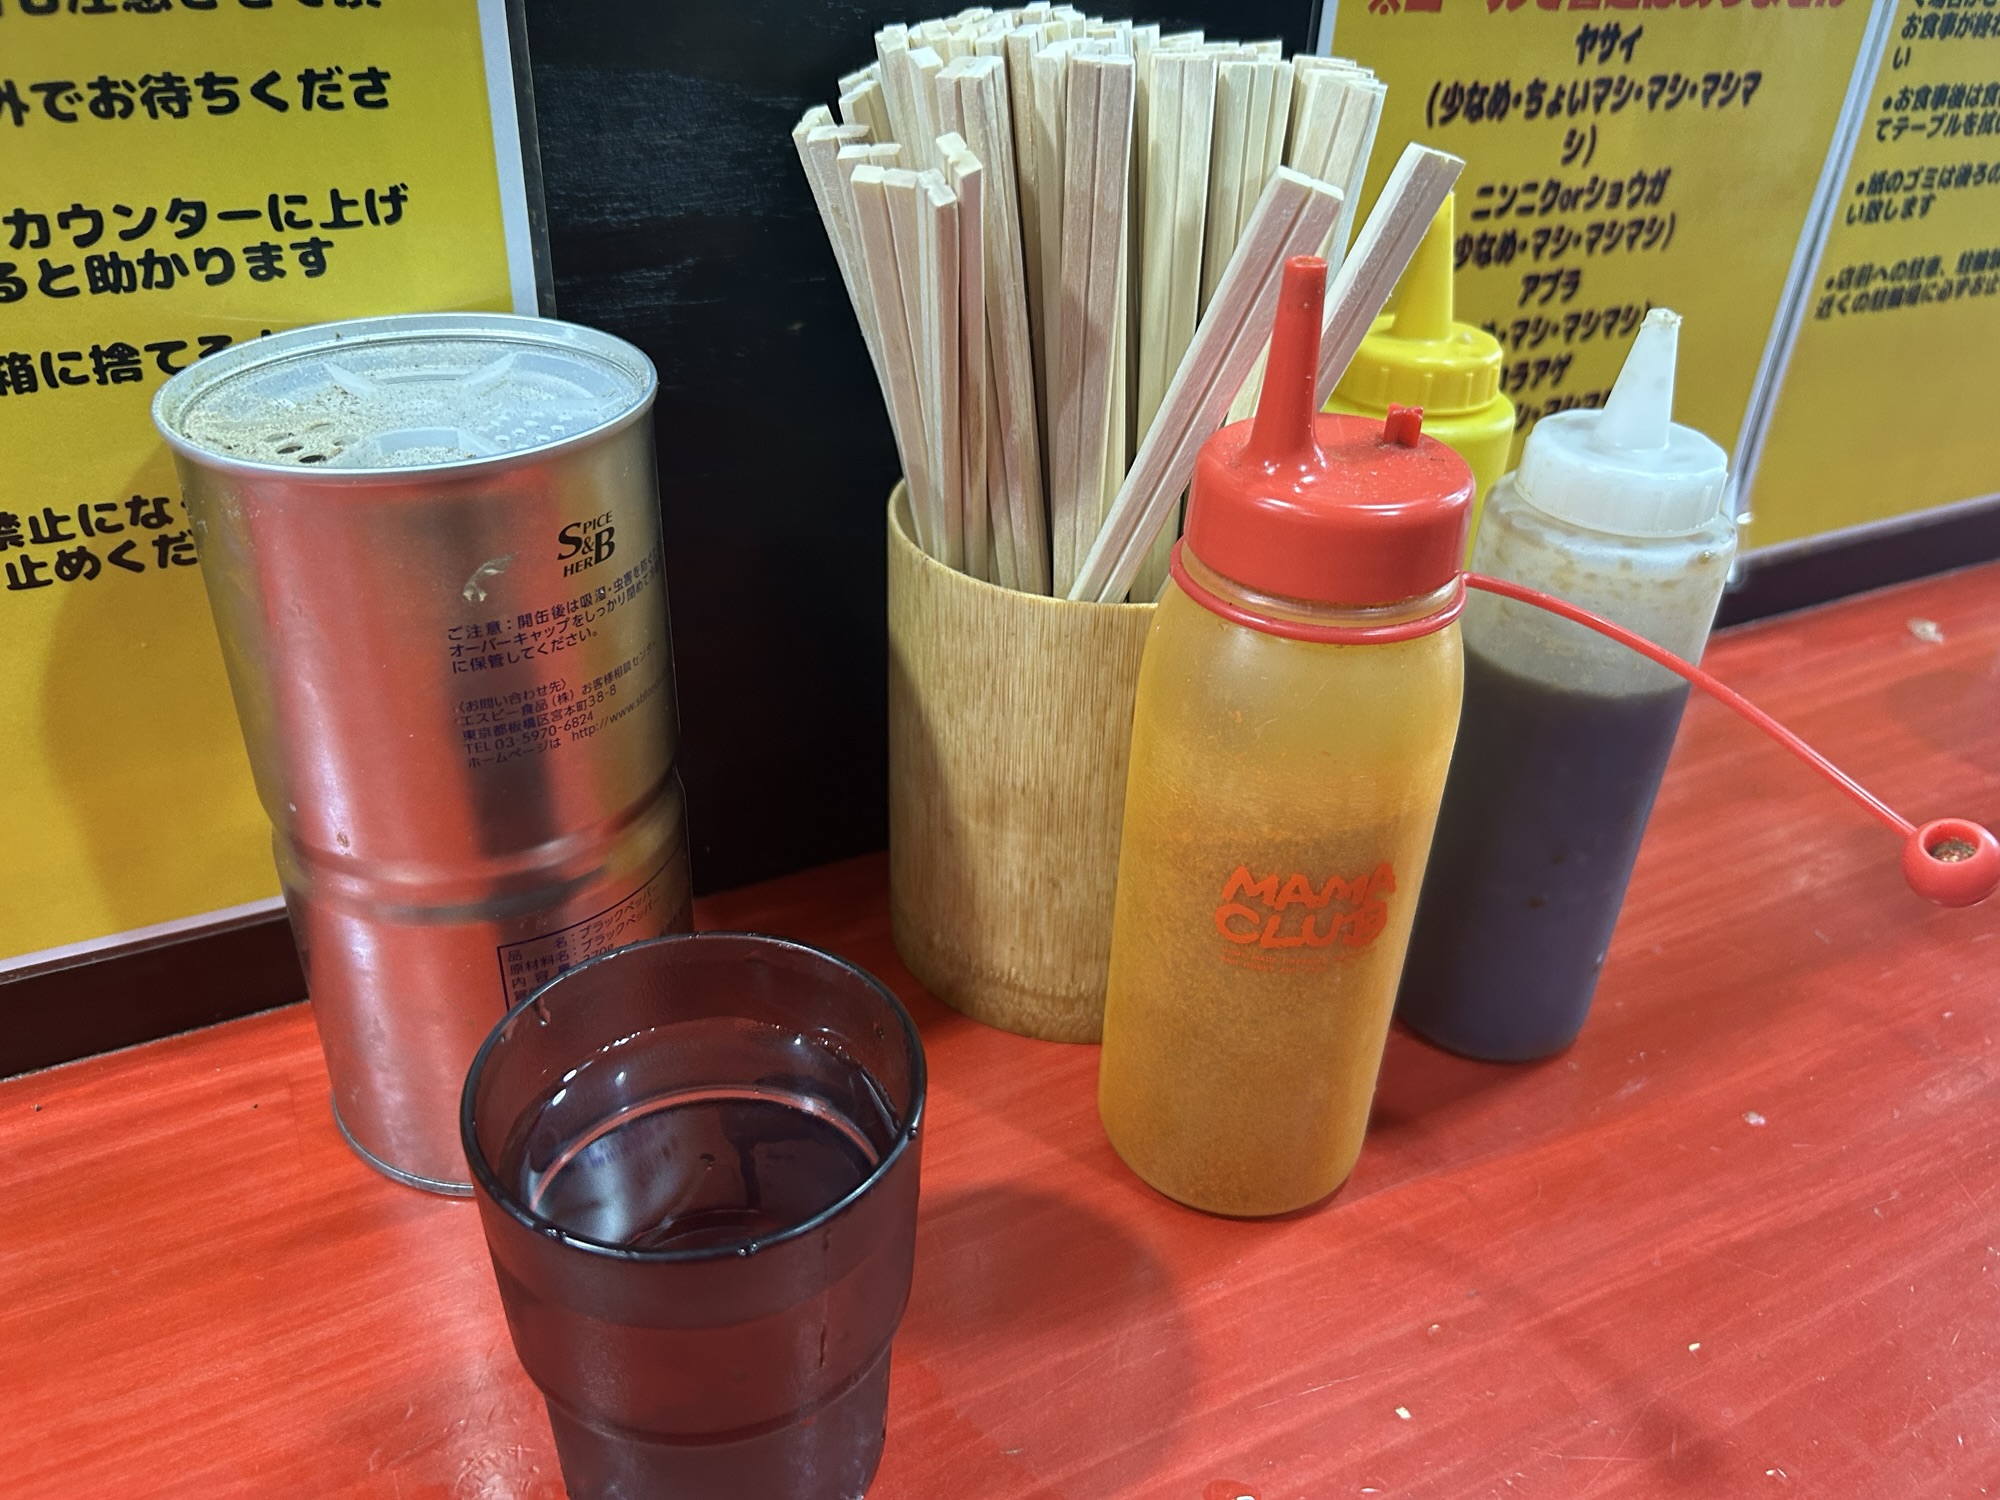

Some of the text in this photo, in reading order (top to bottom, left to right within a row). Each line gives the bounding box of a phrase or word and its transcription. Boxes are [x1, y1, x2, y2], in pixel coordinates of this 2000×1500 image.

[1575, 22, 1644, 67] ヤサイ
[1892, 45, 1911, 70] い
[1471, 167, 1672, 220] ニンニクorショウガ
[2, 184, 410, 251] カウンターに上げ
[0, 237, 335, 304] ると助かります
[1518, 268, 1581, 308] アブラ
[452, 627, 598, 675] に保管してください。
[465, 711, 594, 755] TEL 03-5970-6824
[1221, 861, 1396, 911] MAMA
[1214, 901, 1389, 948] CLUB
